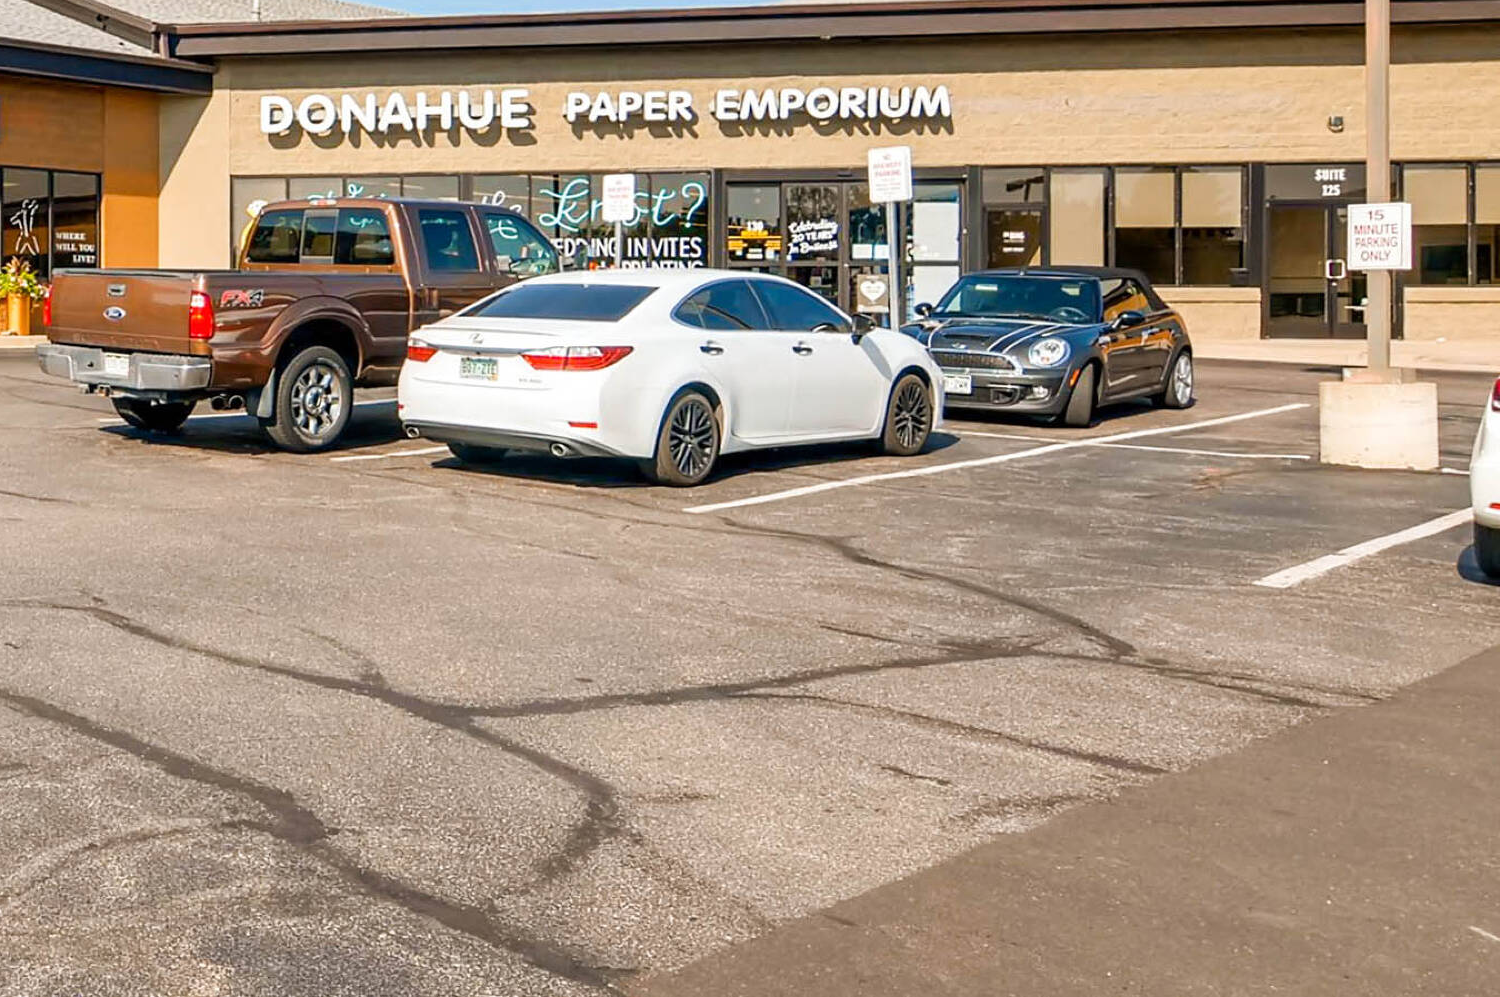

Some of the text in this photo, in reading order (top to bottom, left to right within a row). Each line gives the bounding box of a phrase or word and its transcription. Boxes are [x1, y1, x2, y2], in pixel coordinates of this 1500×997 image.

[566, 85, 951, 122] PAPER EMPORIUM
[260, 89, 529, 133] DONAHUE
[1314, 168, 1347, 182] SUITE
[1321, 184, 1341, 197] 125
[1367, 209, 1385, 221] 15
[788, 218, 839, 236] Celebrating
[1354, 223, 1399, 235] MINUTE
[55, 232, 86, 240] WHERE
[791, 231, 833, 243] 20 YEARS
[1355, 236, 1399, 248] PARKING
[56, 243, 95, 252] WILL YOU
[627, 236, 703, 258] INVITES
[73, 254, 95, 263] LIVE?
[1360, 250, 1391, 262] ONLY
[220, 289, 264, 305] FX4
